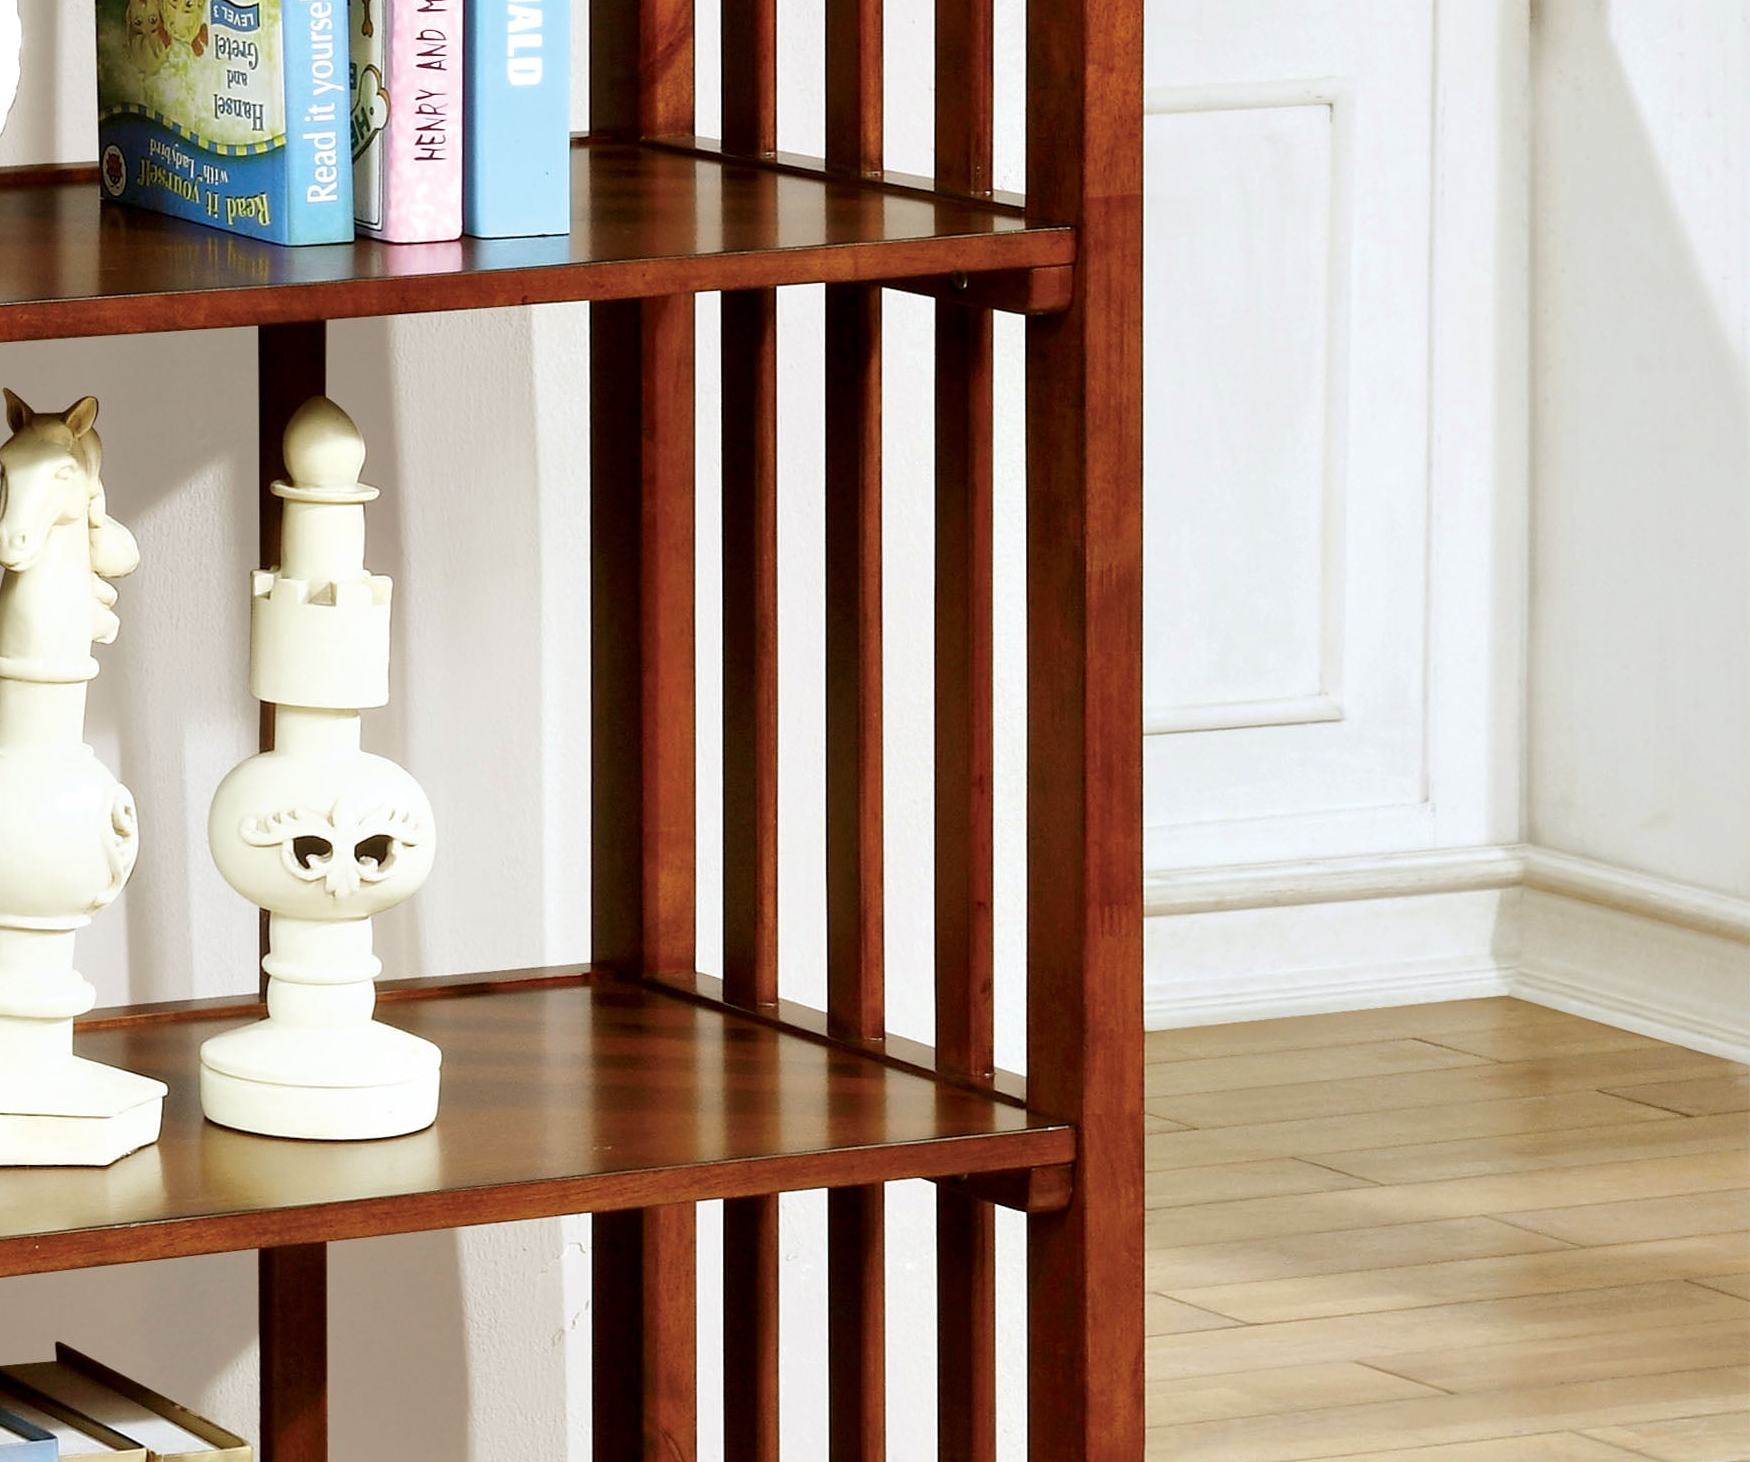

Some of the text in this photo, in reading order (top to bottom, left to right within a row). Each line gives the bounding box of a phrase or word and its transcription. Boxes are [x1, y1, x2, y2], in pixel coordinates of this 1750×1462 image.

[212, 5, 254, 26] LEVEL 3
[214, 34, 259, 70] Gretel
[416, 29, 447, 71] AND
[226, 69, 248, 89] and
[213, 94, 265, 132] Hansel
[304, 103, 336, 123] it
[414, 89, 448, 161] HENRY
[149, 138, 229, 184] with Ladybird
[303, 132, 338, 203] Read
[137, 159, 272, 226] Read it yourself
